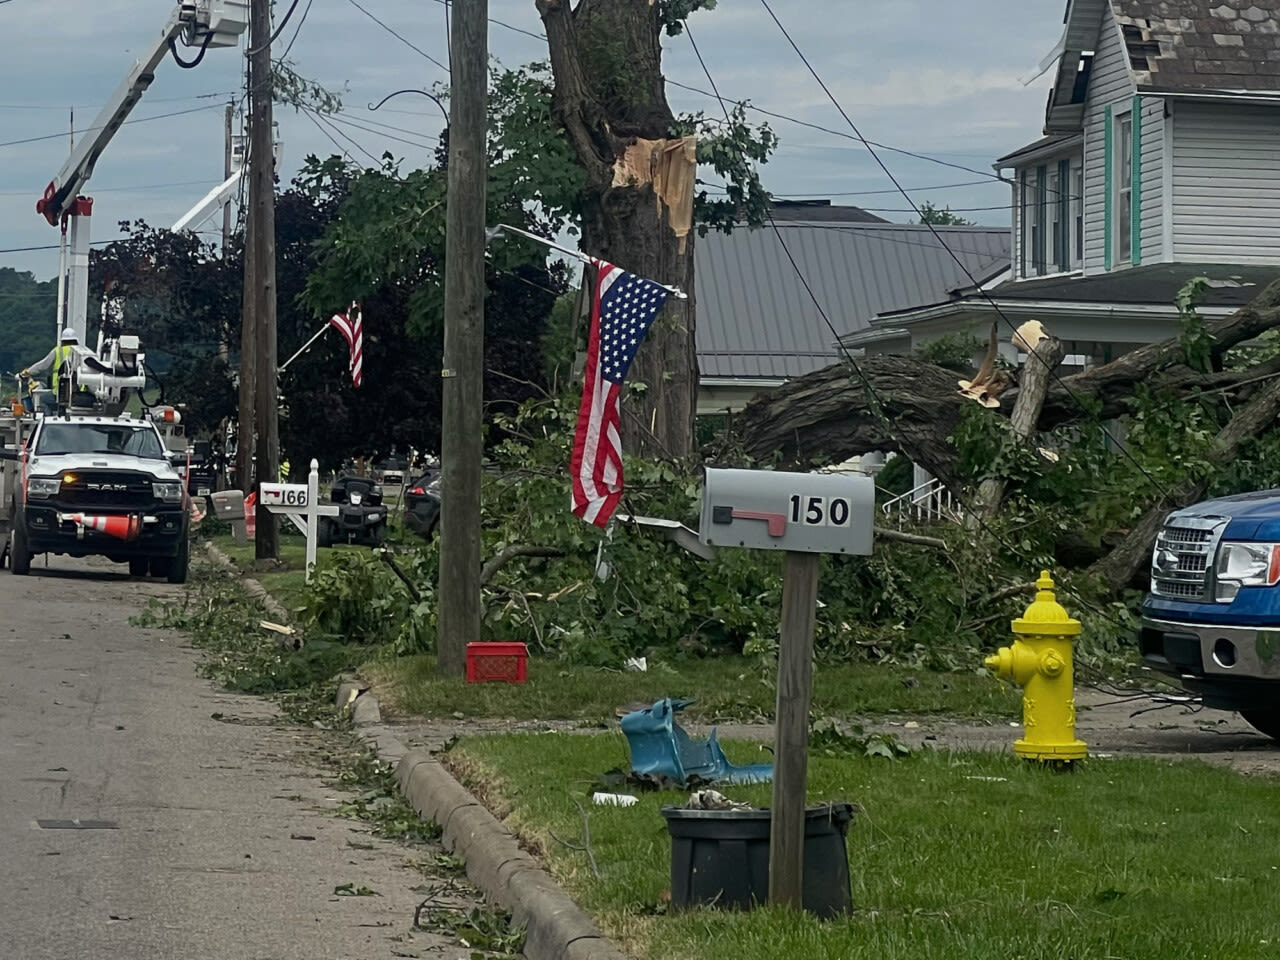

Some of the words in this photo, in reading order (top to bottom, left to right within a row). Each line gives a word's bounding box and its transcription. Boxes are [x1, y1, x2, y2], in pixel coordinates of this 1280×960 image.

[87, 483, 127, 491] RAM
[281, 490, 306, 505] 166
[790, 494, 849, 526] 150
